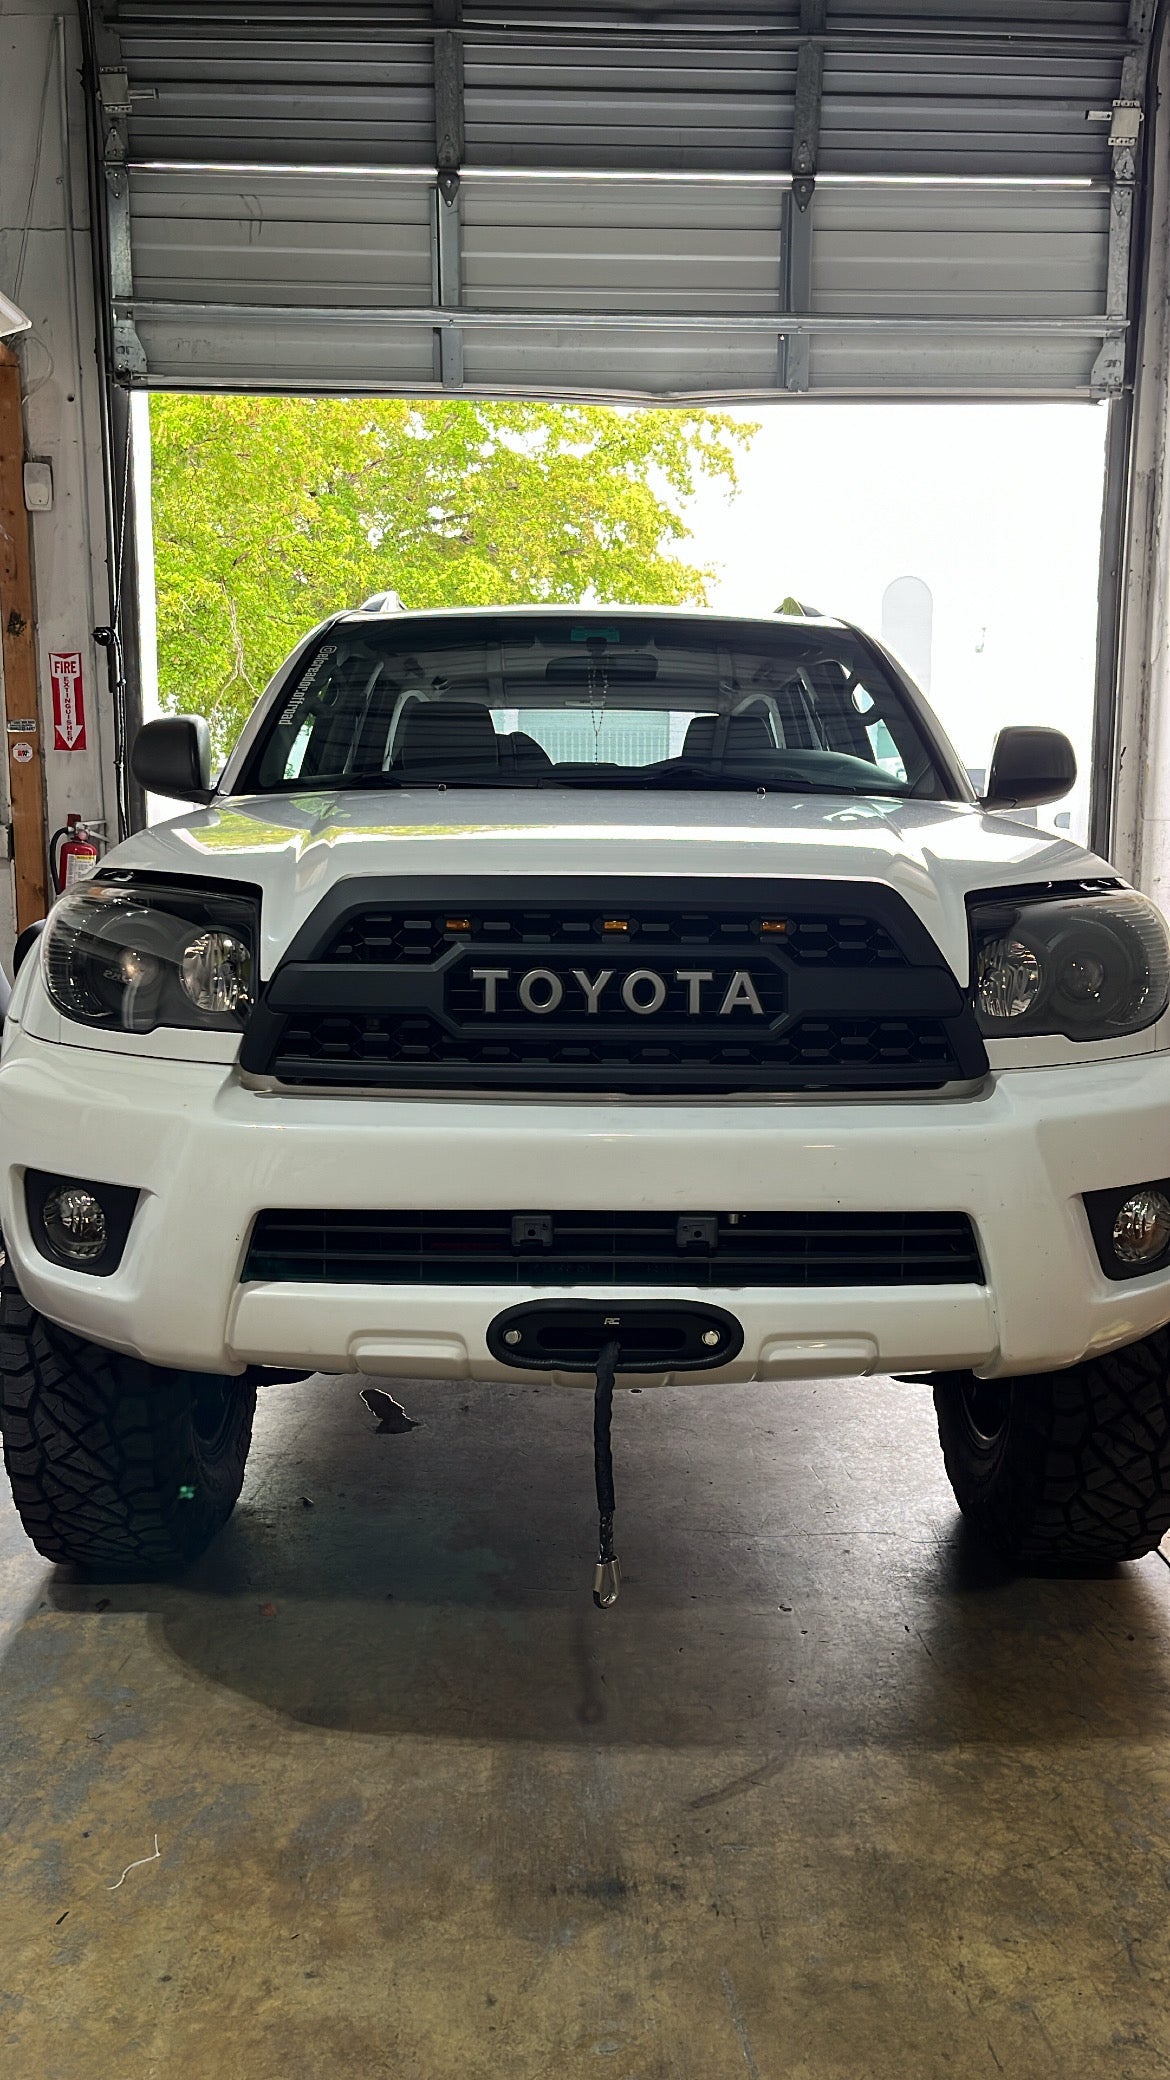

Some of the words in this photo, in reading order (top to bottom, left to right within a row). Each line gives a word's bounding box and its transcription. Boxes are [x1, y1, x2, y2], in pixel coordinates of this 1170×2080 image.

[54, 660, 77, 674] FIRE
[63, 676, 74, 742] EXTINGUISHER
[472, 969, 764, 1015] TOYOTA
